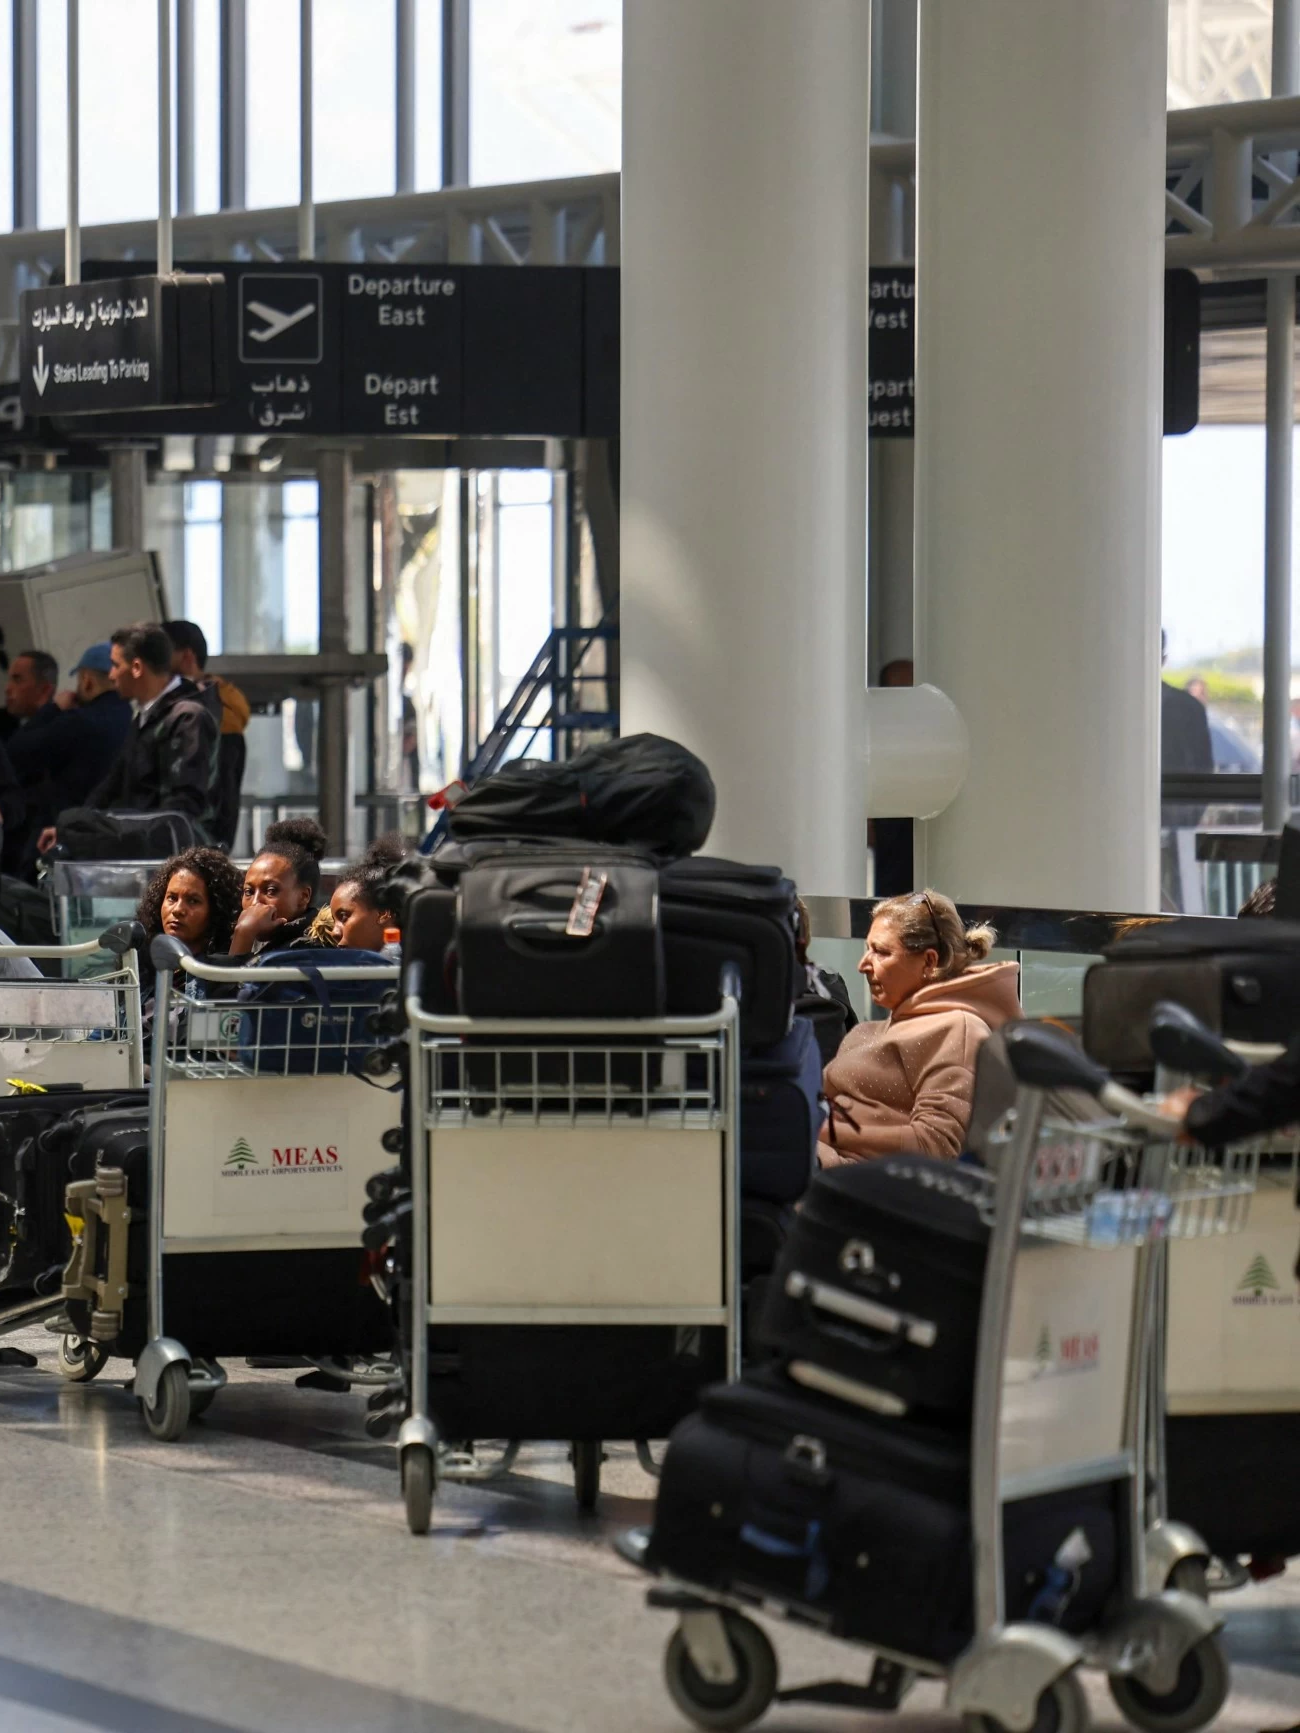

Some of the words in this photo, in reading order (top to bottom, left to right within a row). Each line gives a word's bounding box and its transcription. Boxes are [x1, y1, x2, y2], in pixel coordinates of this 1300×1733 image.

[348, 273, 456, 299] Departure
[870, 278, 915, 299] artu
[378, 303, 426, 326] East
[868, 308, 909, 329] est
[53, 362, 77, 384] Stairs
[77, 361, 108, 385] Leading
[108, 359, 119, 380] To
[119, 358, 150, 382] Parking
[251, 374, 311, 397] ذهاب
[364, 373, 440, 400] Départ
[384, 404, 421, 426] Est
[868, 404, 912, 428] uest
[271, 1146, 339, 1168] MEAS
[251, 1168, 269, 1176] EAST
[271, 1166, 307, 1176] AIRPORTS
[308, 1164, 343, 1174] SERVICES
